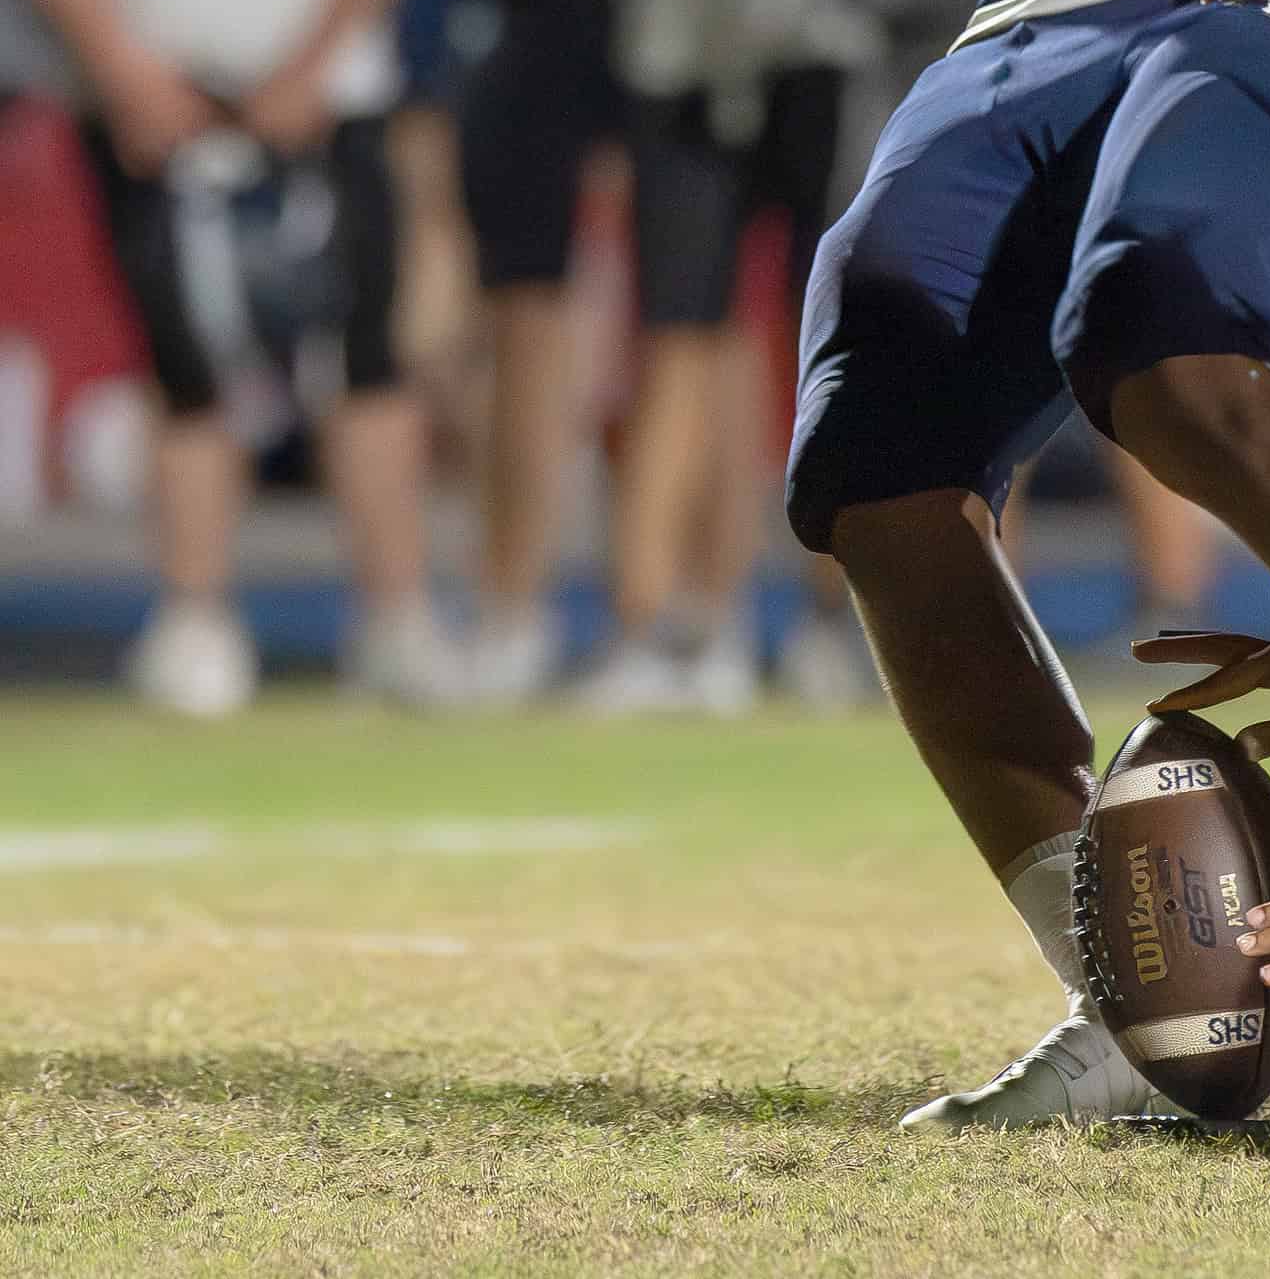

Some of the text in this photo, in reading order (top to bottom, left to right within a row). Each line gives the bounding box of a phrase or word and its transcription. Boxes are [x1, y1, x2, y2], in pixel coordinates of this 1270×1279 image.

[1158, 764, 1213, 791] SHS
[1178, 856, 1217, 949] GST
[1208, 1014, 1260, 1044] SHS
